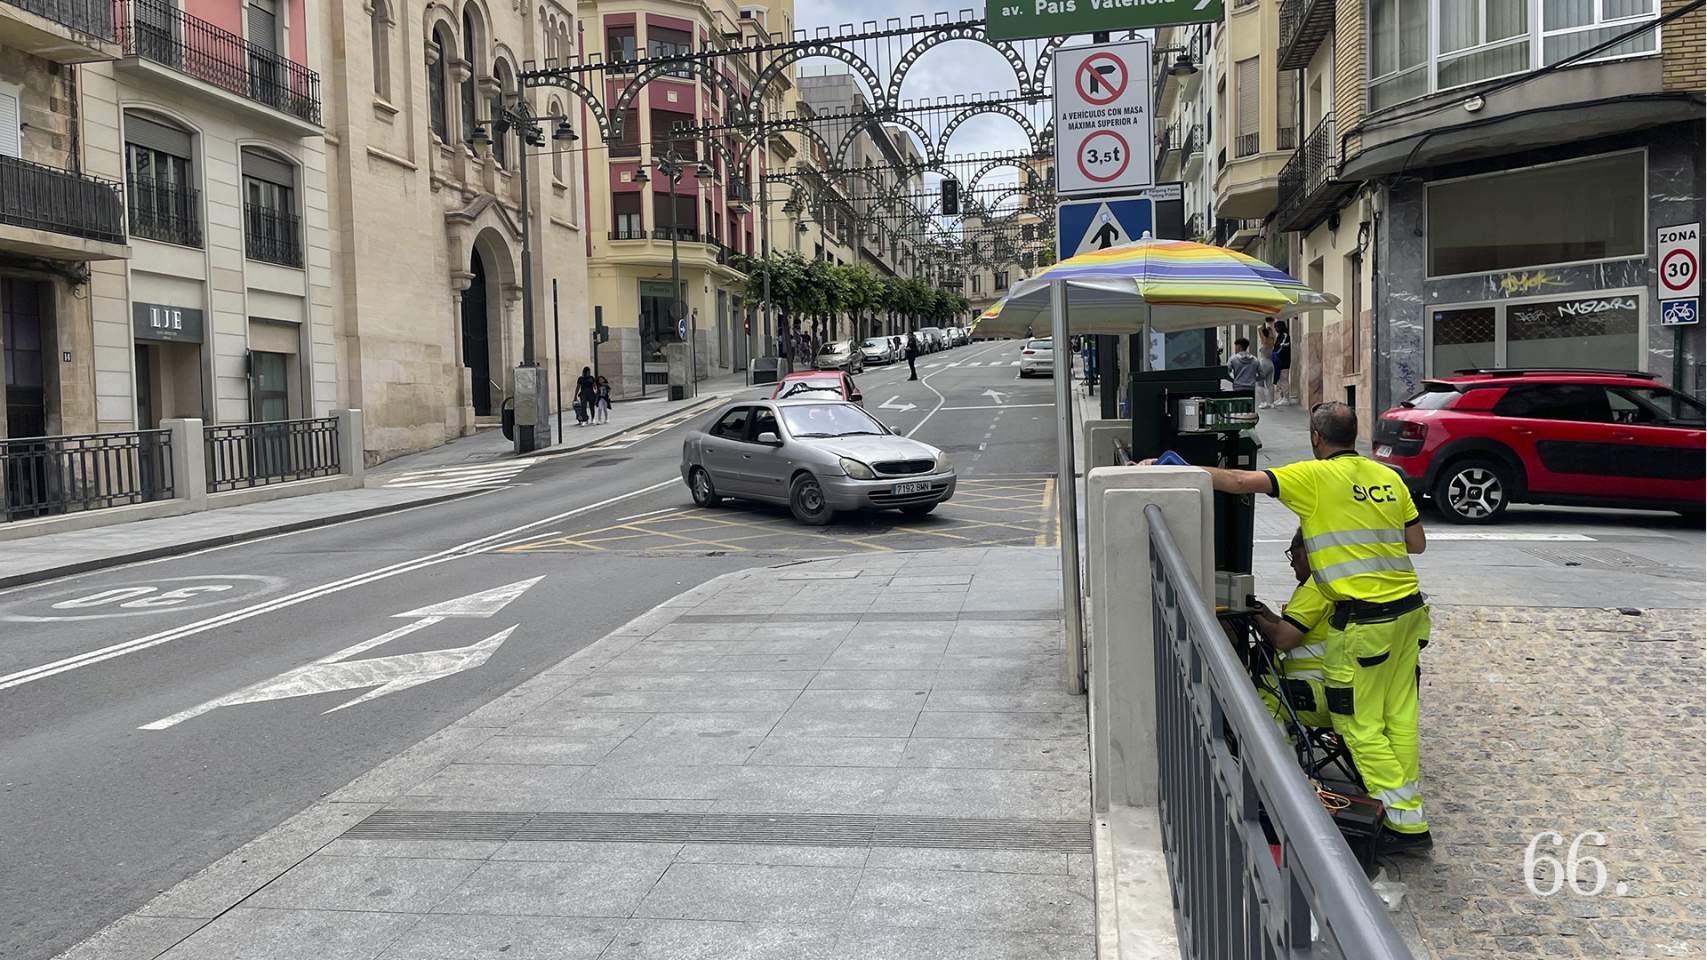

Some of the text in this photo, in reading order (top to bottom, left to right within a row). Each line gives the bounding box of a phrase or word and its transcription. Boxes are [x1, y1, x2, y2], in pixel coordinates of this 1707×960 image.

[1001, 6, 1023, 16] av.
[1062, 113, 1067, 121] A
[1107, 107, 1122, 117] CON
[1123, 106, 1143, 115] MASA
[1097, 118, 1132, 128] SUPERIOR
[1133, 117, 1138, 125] A
[1660, 230, 1697, 243] ZONA
[1667, 262, 1690, 278] 30
[1352, 484, 1397, 503] SICE
